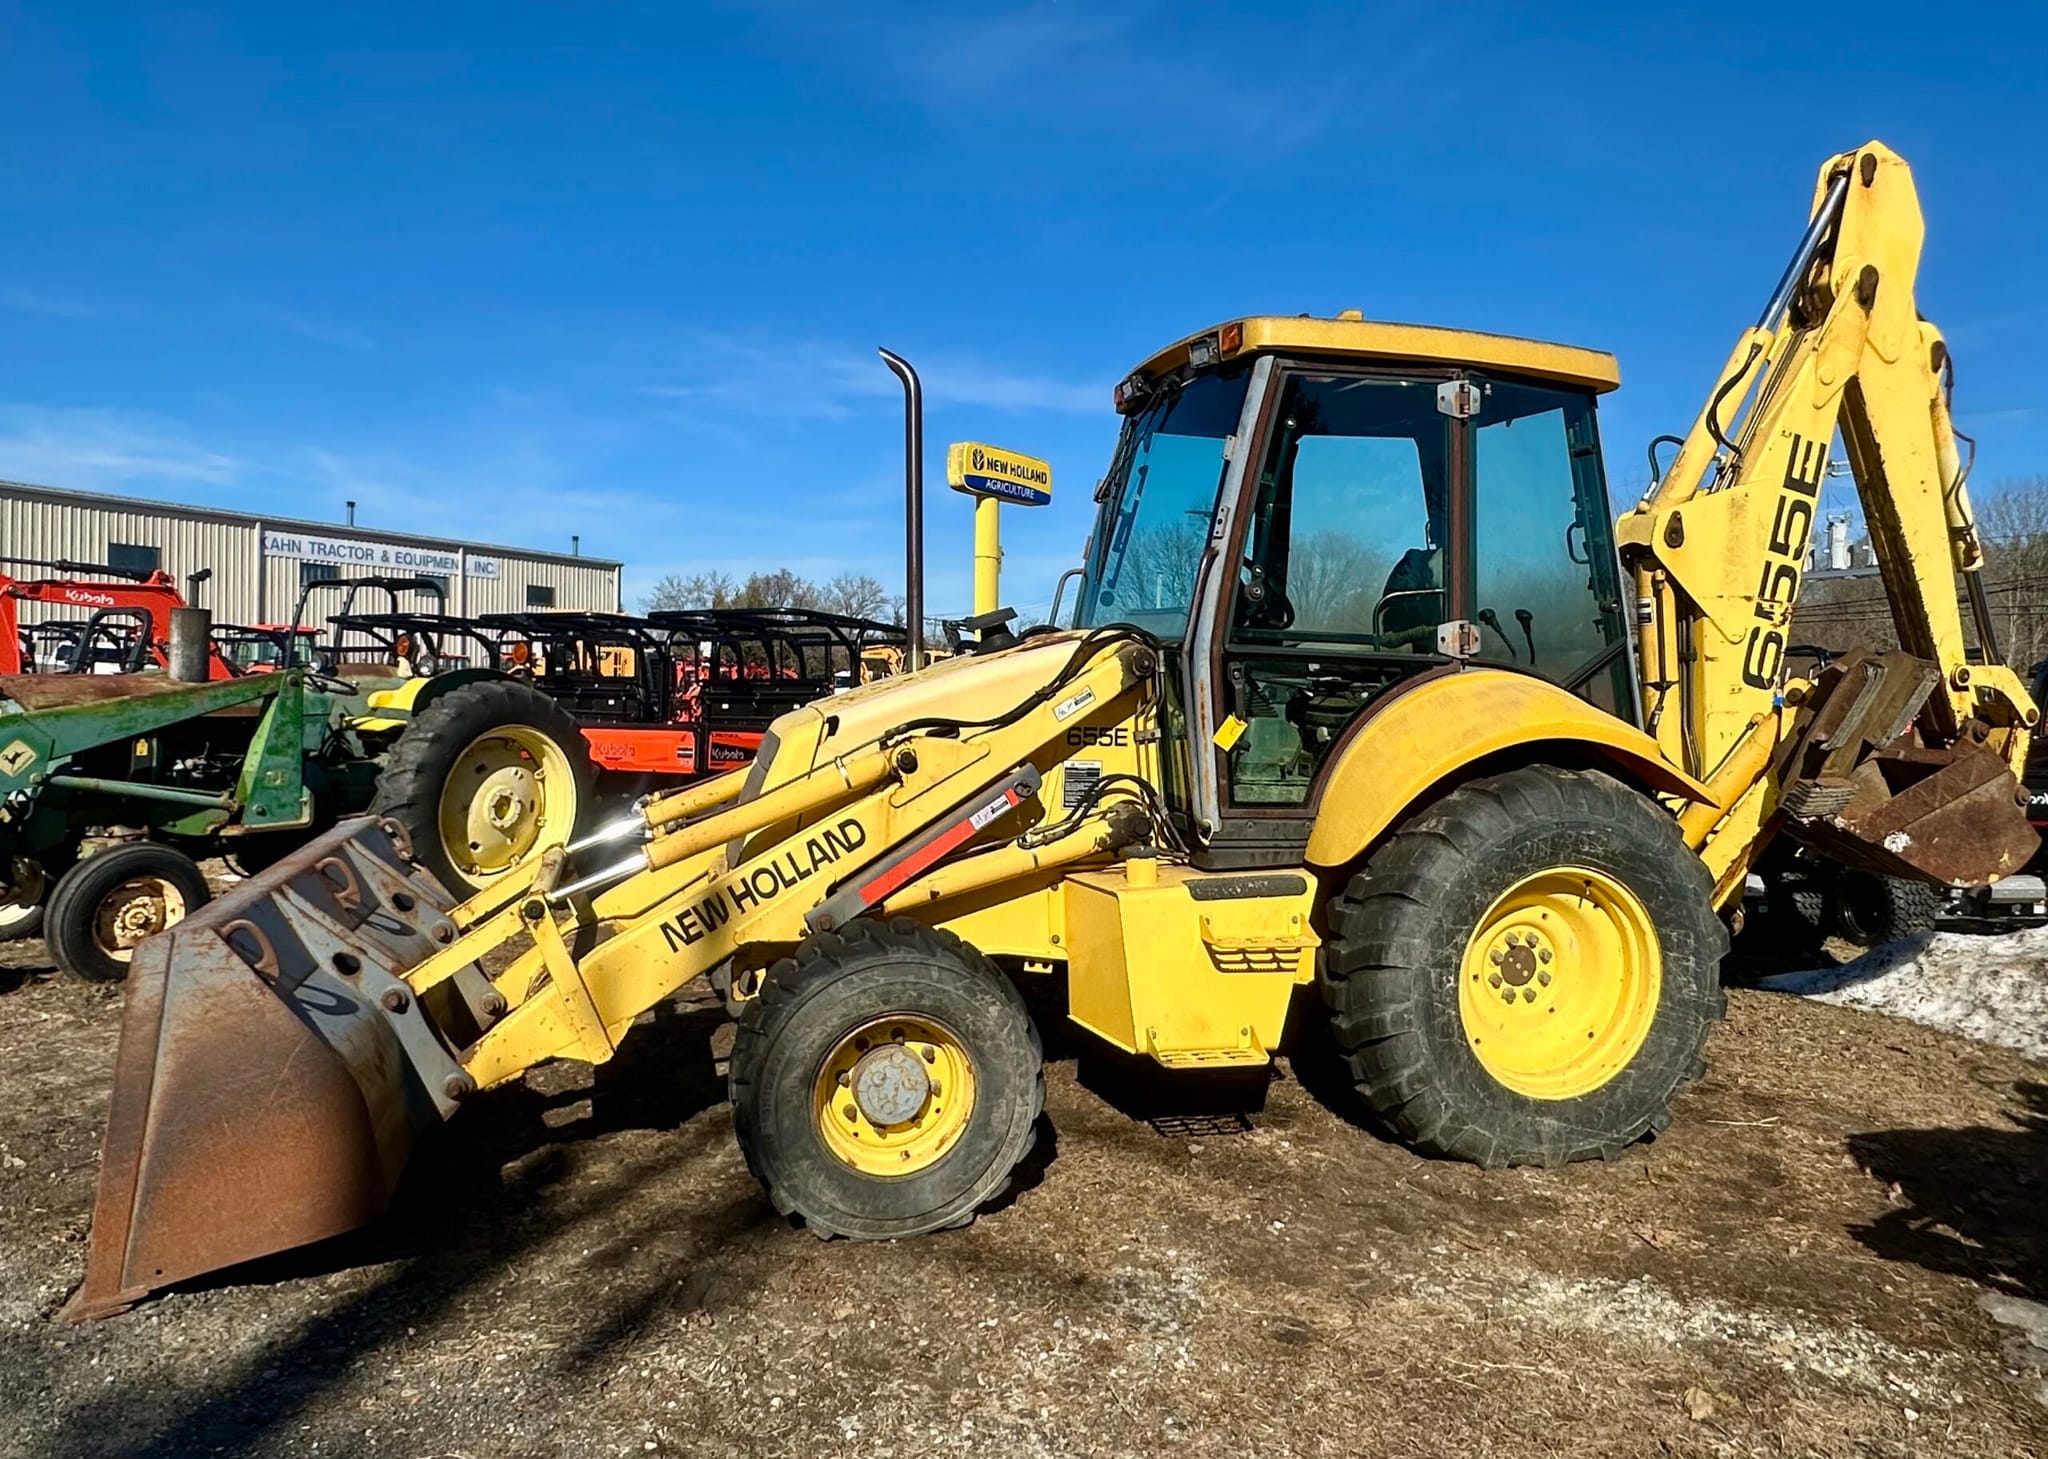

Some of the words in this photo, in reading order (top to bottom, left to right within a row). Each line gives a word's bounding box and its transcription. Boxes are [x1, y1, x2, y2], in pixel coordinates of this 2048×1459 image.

[986, 457, 1008, 475] NEW
[1010, 463, 1048, 485] HOLLAND
[985, 479, 1035, 499] AGRICULTURE
[308, 541, 375, 561] TRACTOR
[381, 550, 390, 562] &
[395, 551, 460, 571] EQUIPMEN
[474, 561, 497, 575] INC.
[1743, 433, 1828, 691] 655E
[65, 589, 115, 605] Kubota
[1066, 727, 1129, 747] 655E
[711, 747, 745, 760] Kubota
[659, 891, 730, 954] NEW
[727, 818, 866, 914] HOLLAND
